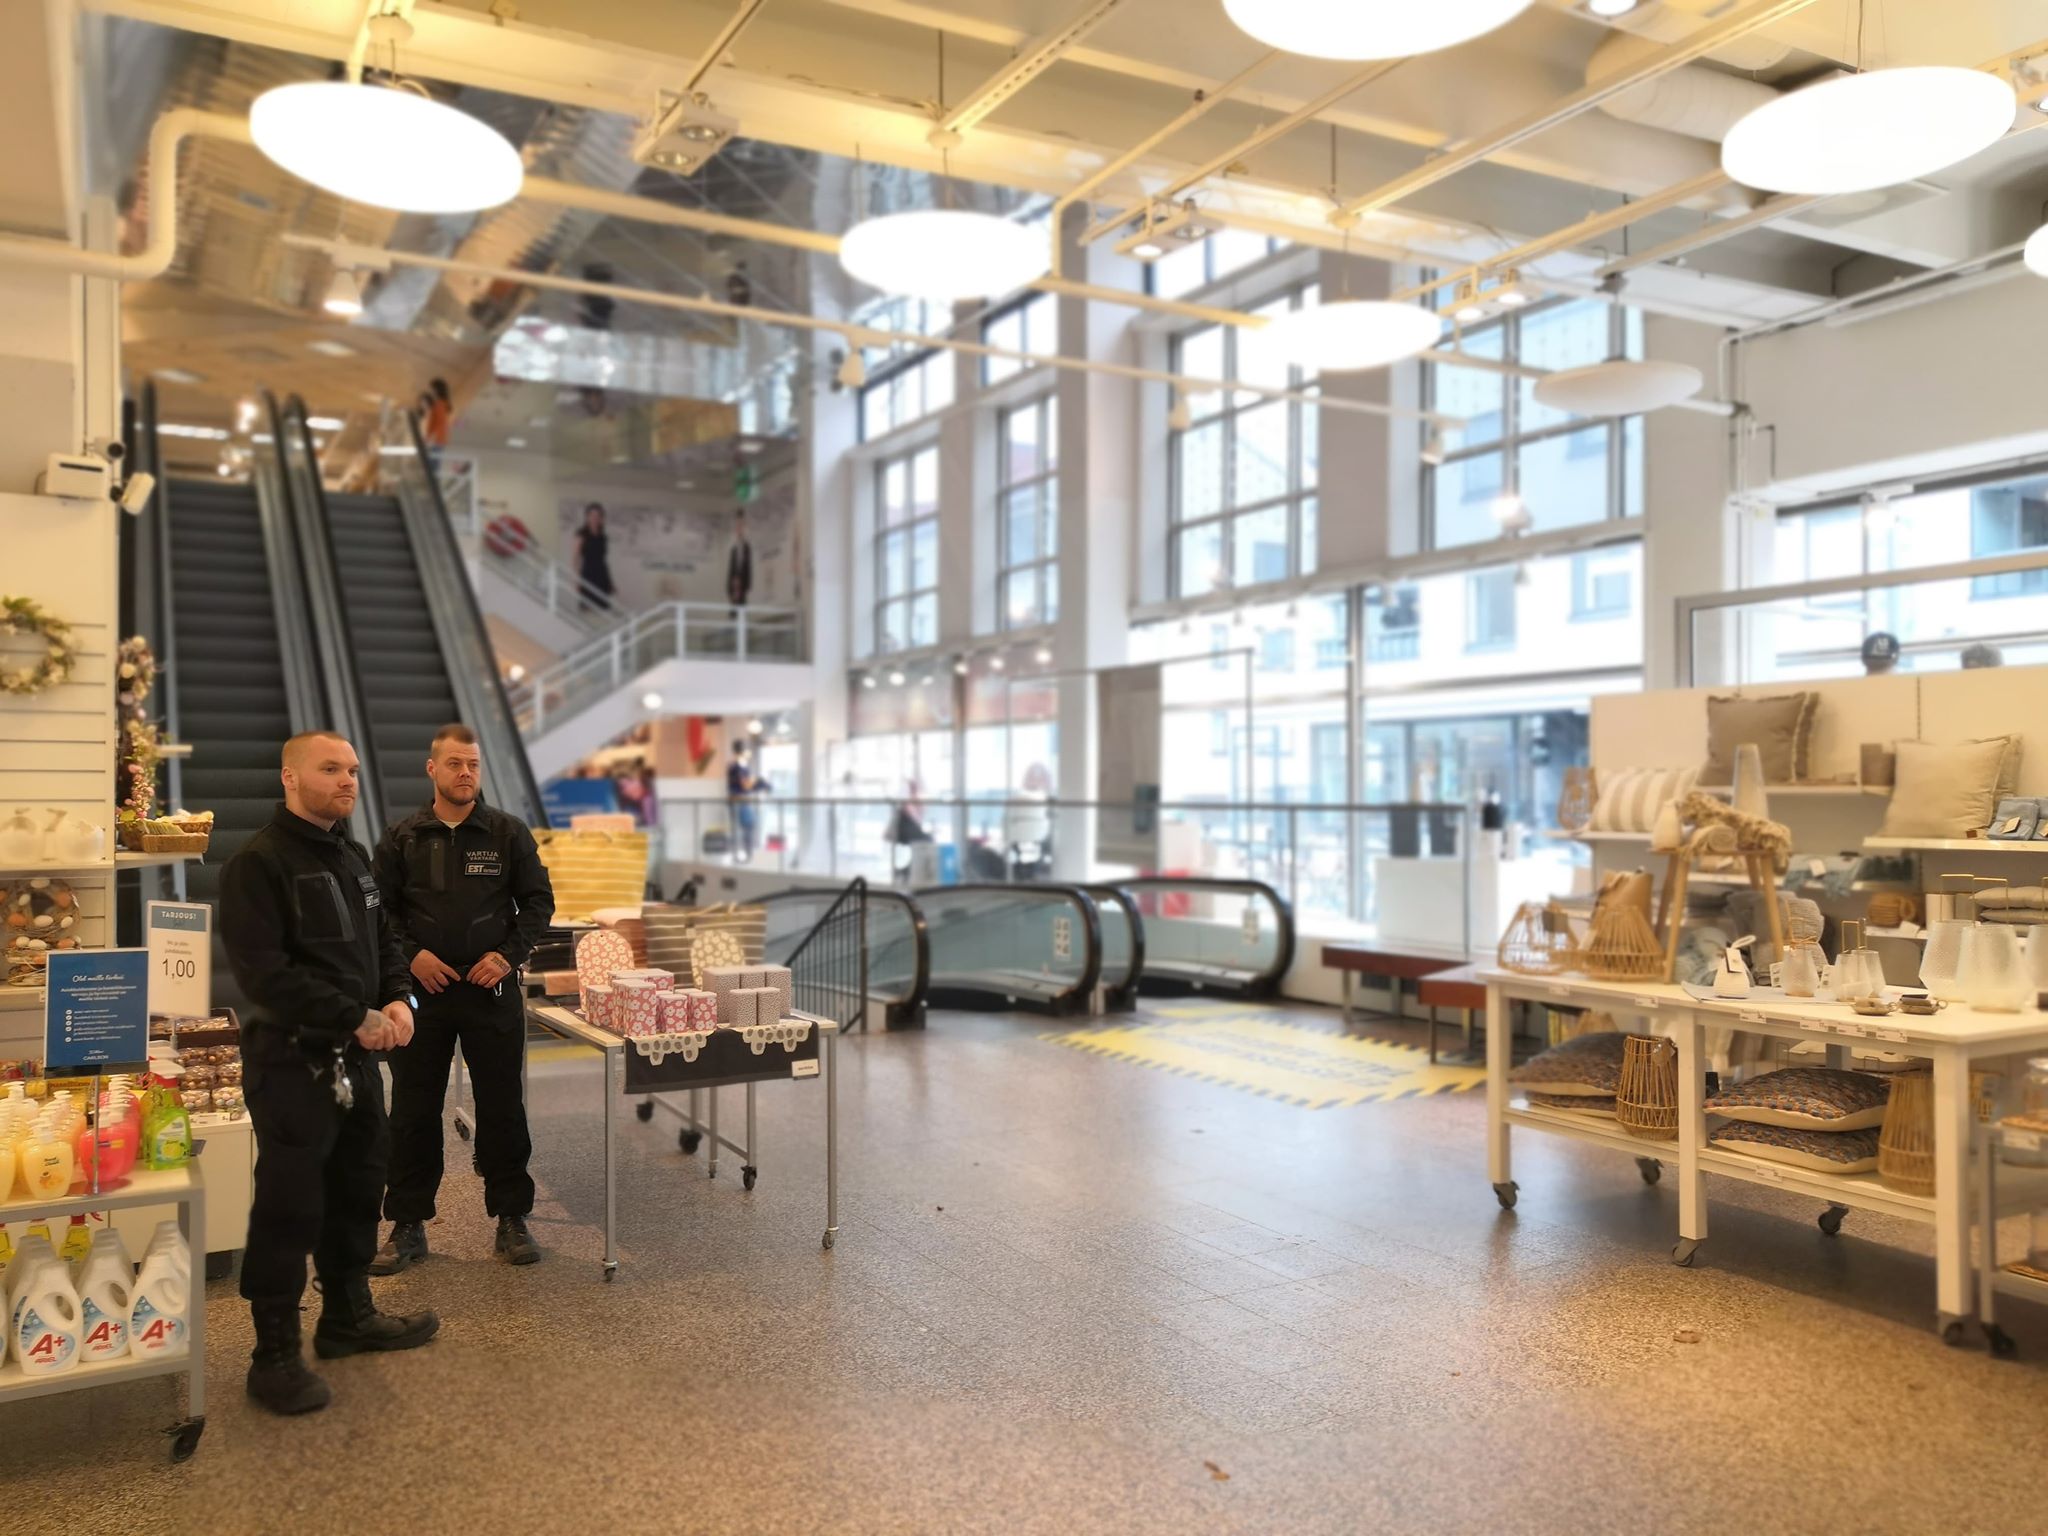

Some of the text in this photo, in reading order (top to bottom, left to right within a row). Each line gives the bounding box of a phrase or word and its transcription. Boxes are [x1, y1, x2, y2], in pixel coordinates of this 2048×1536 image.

[468, 865, 484, 873] EST
[162, 911, 197, 920] TARJOUS!
[162, 958, 196, 980] 1,00
[85, 1321, 122, 1344] A+
[140, 1319, 177, 1342] A+
[28, 1334, 65, 1356] A+
